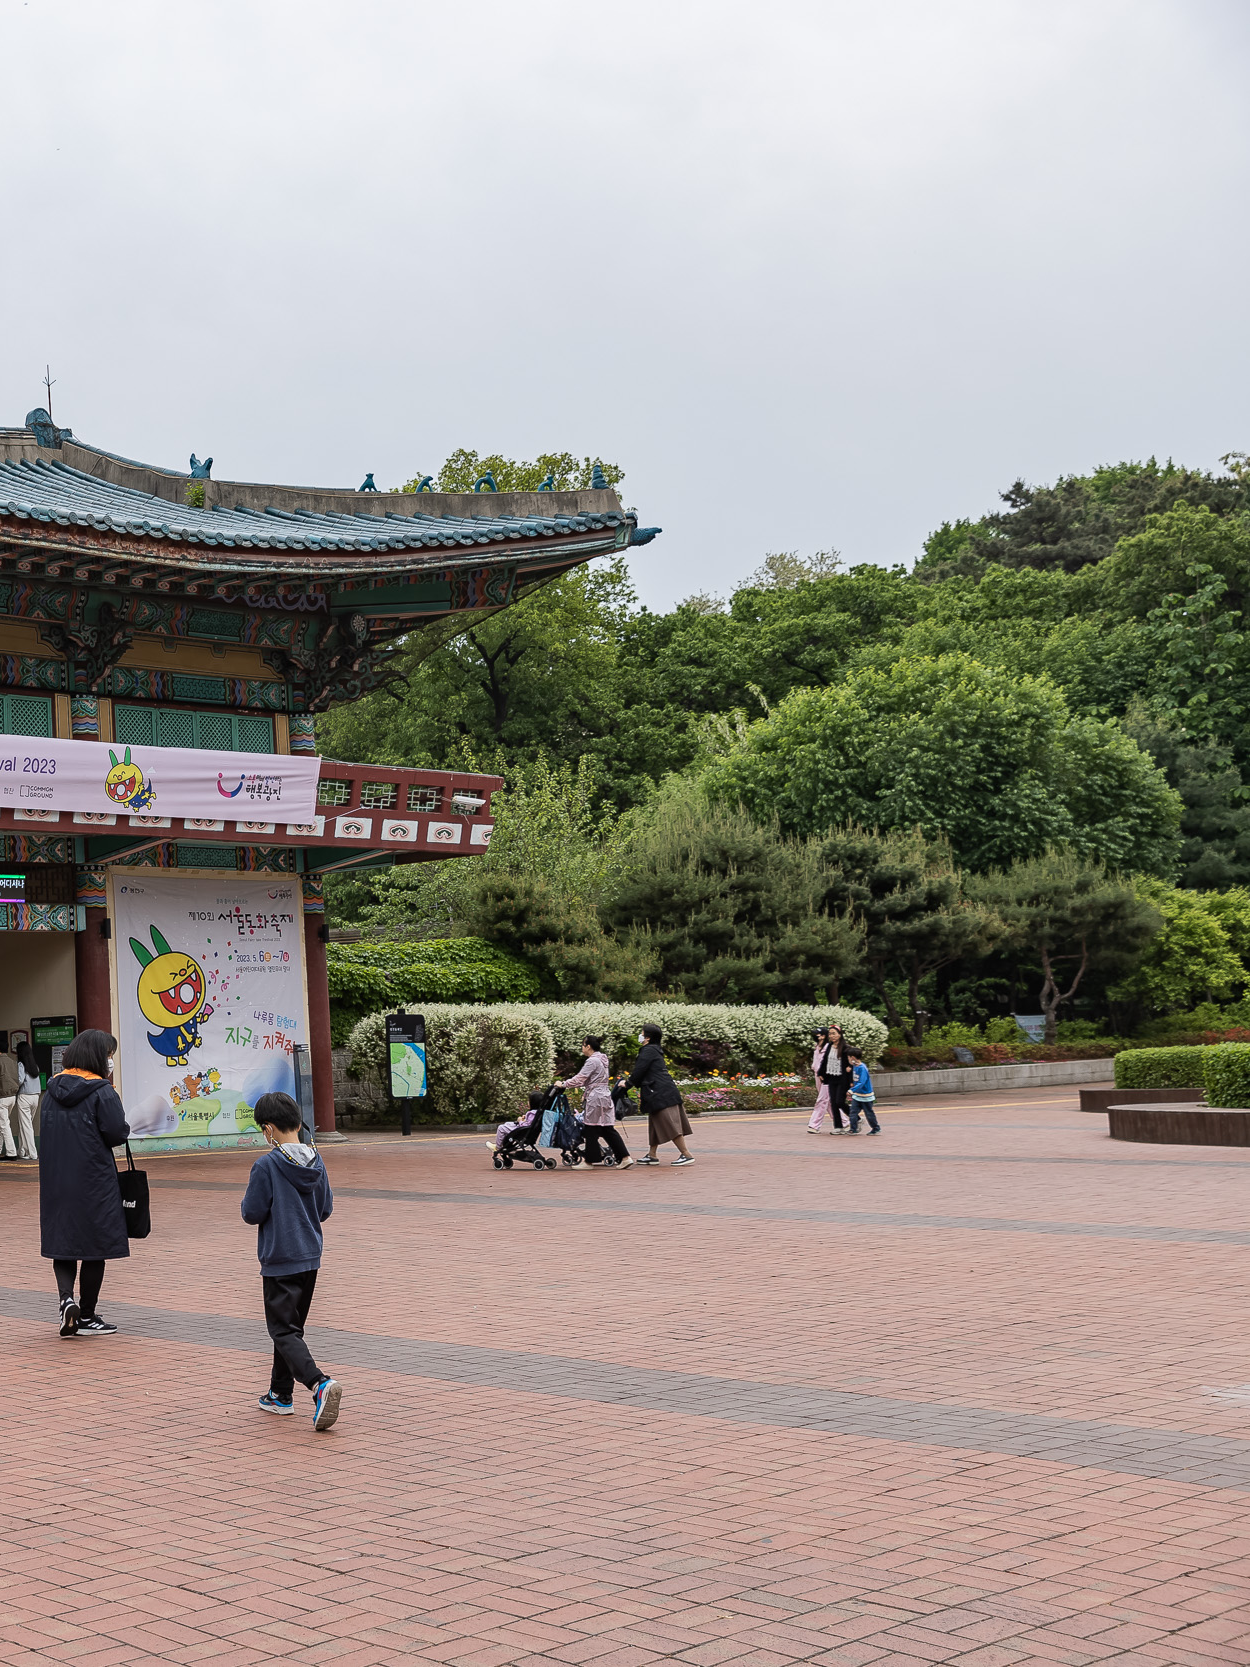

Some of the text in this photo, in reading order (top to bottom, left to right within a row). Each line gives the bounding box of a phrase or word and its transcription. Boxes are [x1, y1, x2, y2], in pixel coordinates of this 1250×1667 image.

[23, 757, 57, 776] 2023
[246, 783, 282, 801] 행복광진
[0, 878, 25, 889] 어디서나
[188, 906, 294, 938] 제10회 서울동화축제
[253, 1010, 297, 1030] 나루몽 탐험대
[187, 1112, 215, 1121] 서울특별시
